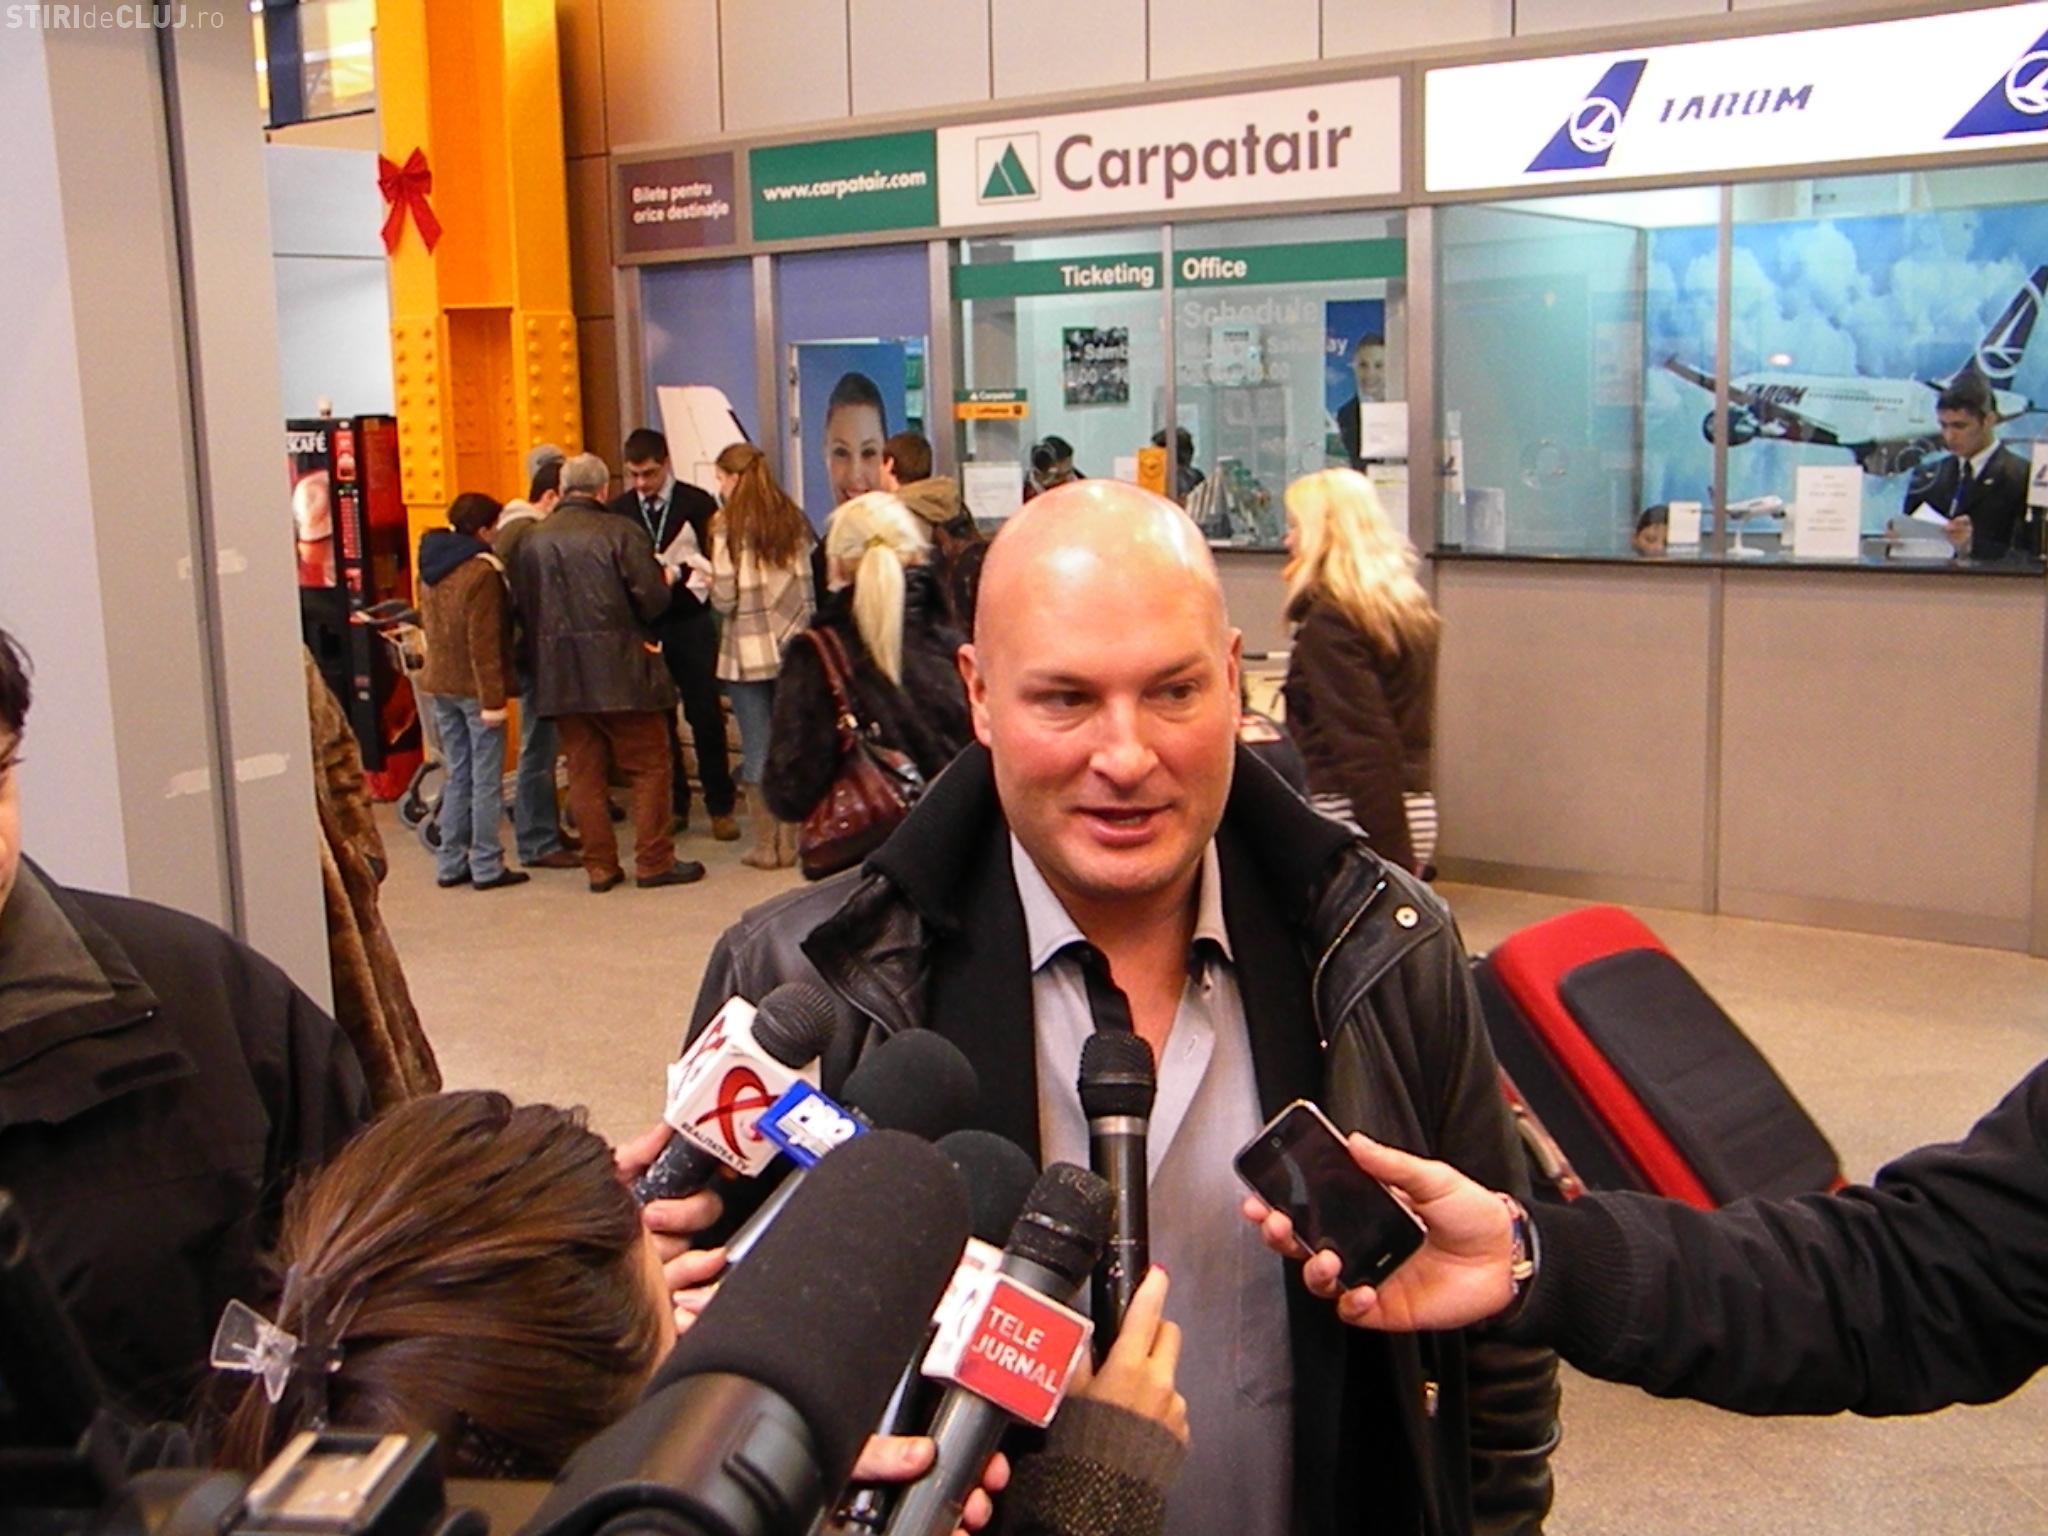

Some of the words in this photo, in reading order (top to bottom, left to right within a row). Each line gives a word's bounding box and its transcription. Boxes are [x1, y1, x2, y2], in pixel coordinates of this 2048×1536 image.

[1659, 84, 1815, 123] TAROM
[1054, 109, 1353, 200] Carpatair
[632, 186, 669, 204] Bilete
[670, 181, 713, 203] pentru
[762, 169, 927, 200] www.carpatair.com
[633, 207, 665, 224] orice
[1060, 262, 1155, 289] Ticketing
[1181, 256, 1248, 281] Office
[988, 1305, 1045, 1352] TELE
[971, 1334, 1058, 1394] JURNAL
